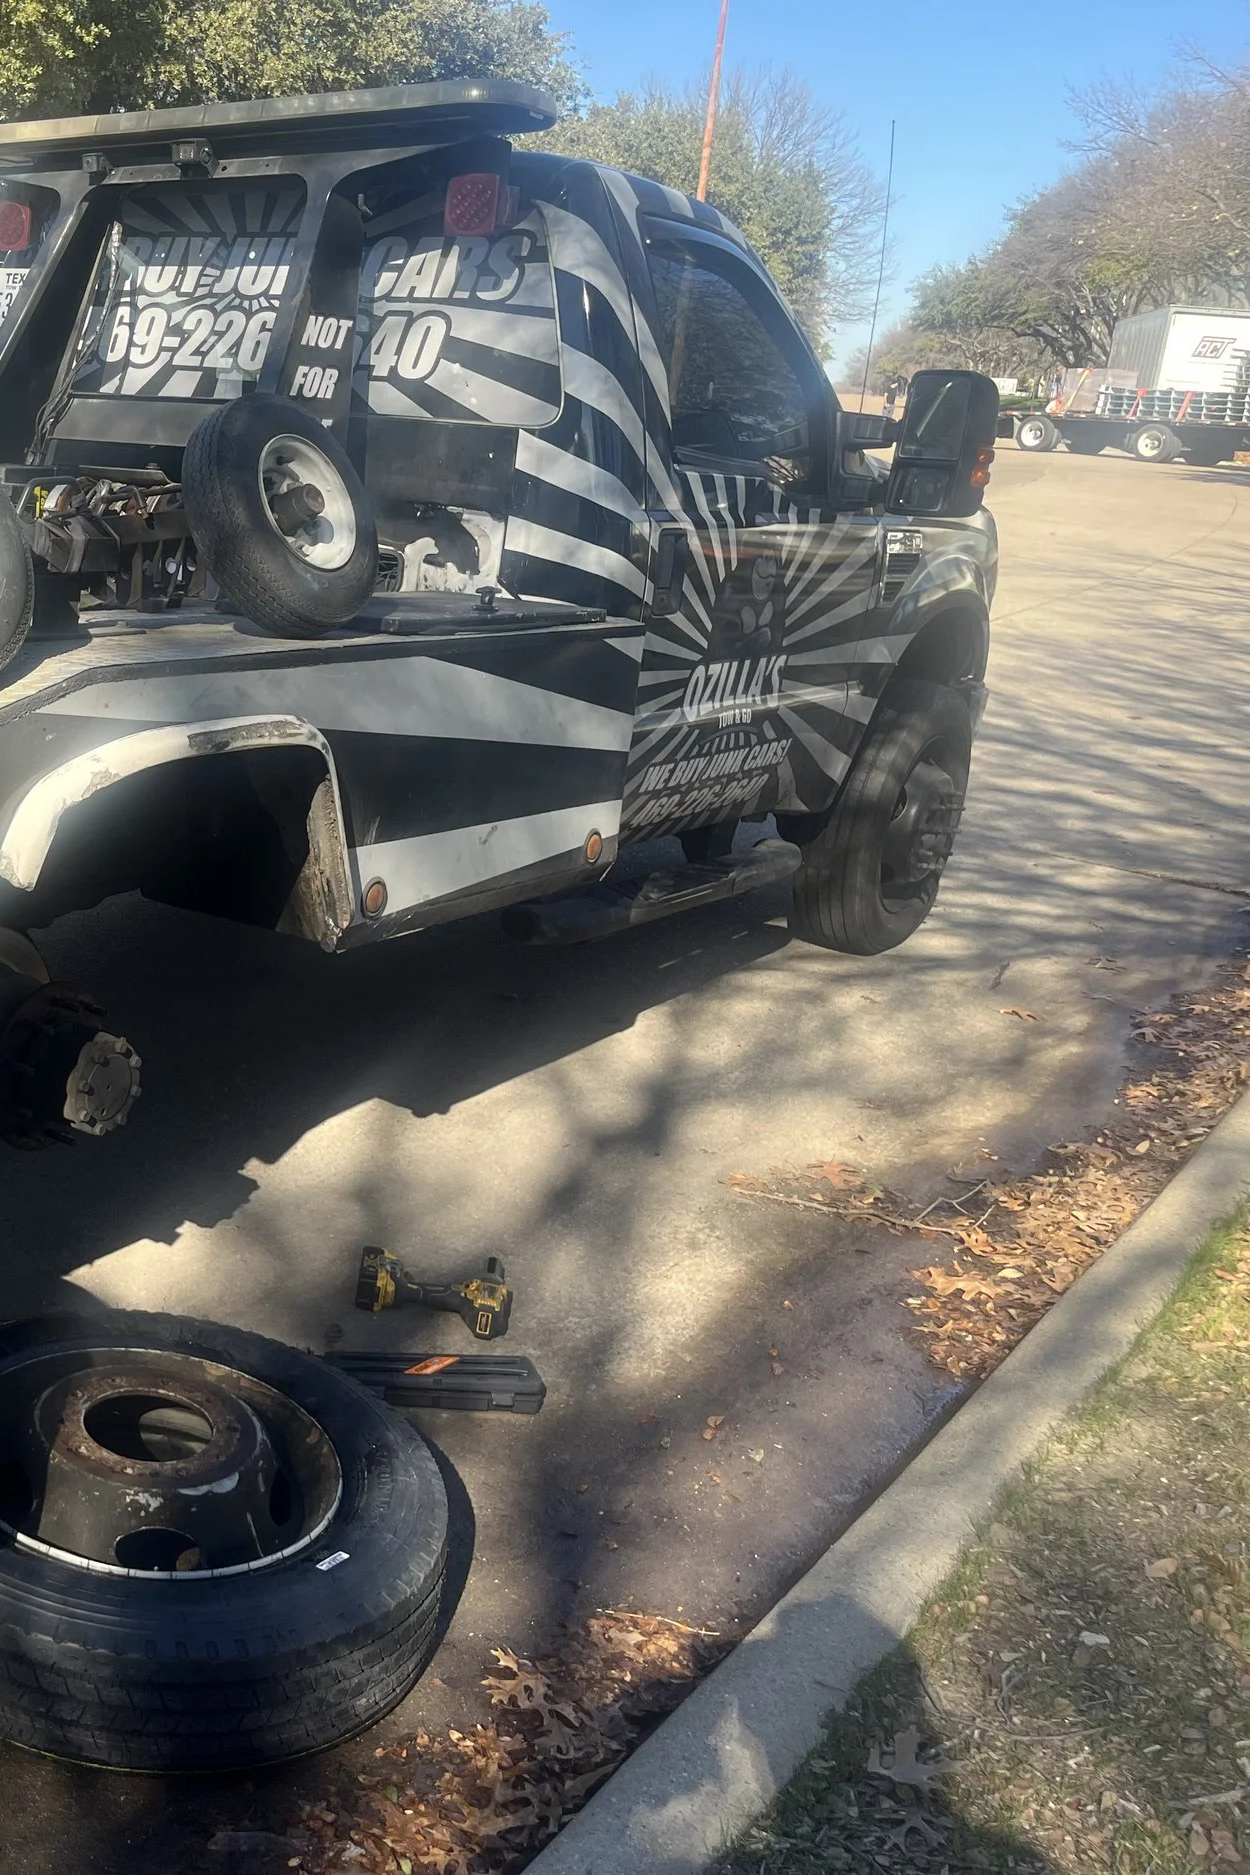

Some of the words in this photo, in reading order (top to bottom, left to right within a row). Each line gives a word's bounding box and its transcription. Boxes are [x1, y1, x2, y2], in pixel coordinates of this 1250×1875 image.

[6, 272, 27, 285] TEX
[361, 232, 531, 301] CARS
[301, 315, 353, 350] NOT
[289, 365, 339, 399] FOR
[683, 655, 787, 722] OZILLA'S
[718, 709, 734, 729] TOW
[735, 708, 741, 723] &
[741, 708, 752, 724] GO
[638, 763, 675, 793] WE
[667, 755, 710, 787] BUY
[701, 747, 750, 780] JUNK
[743, 737, 792, 771] CARS!
